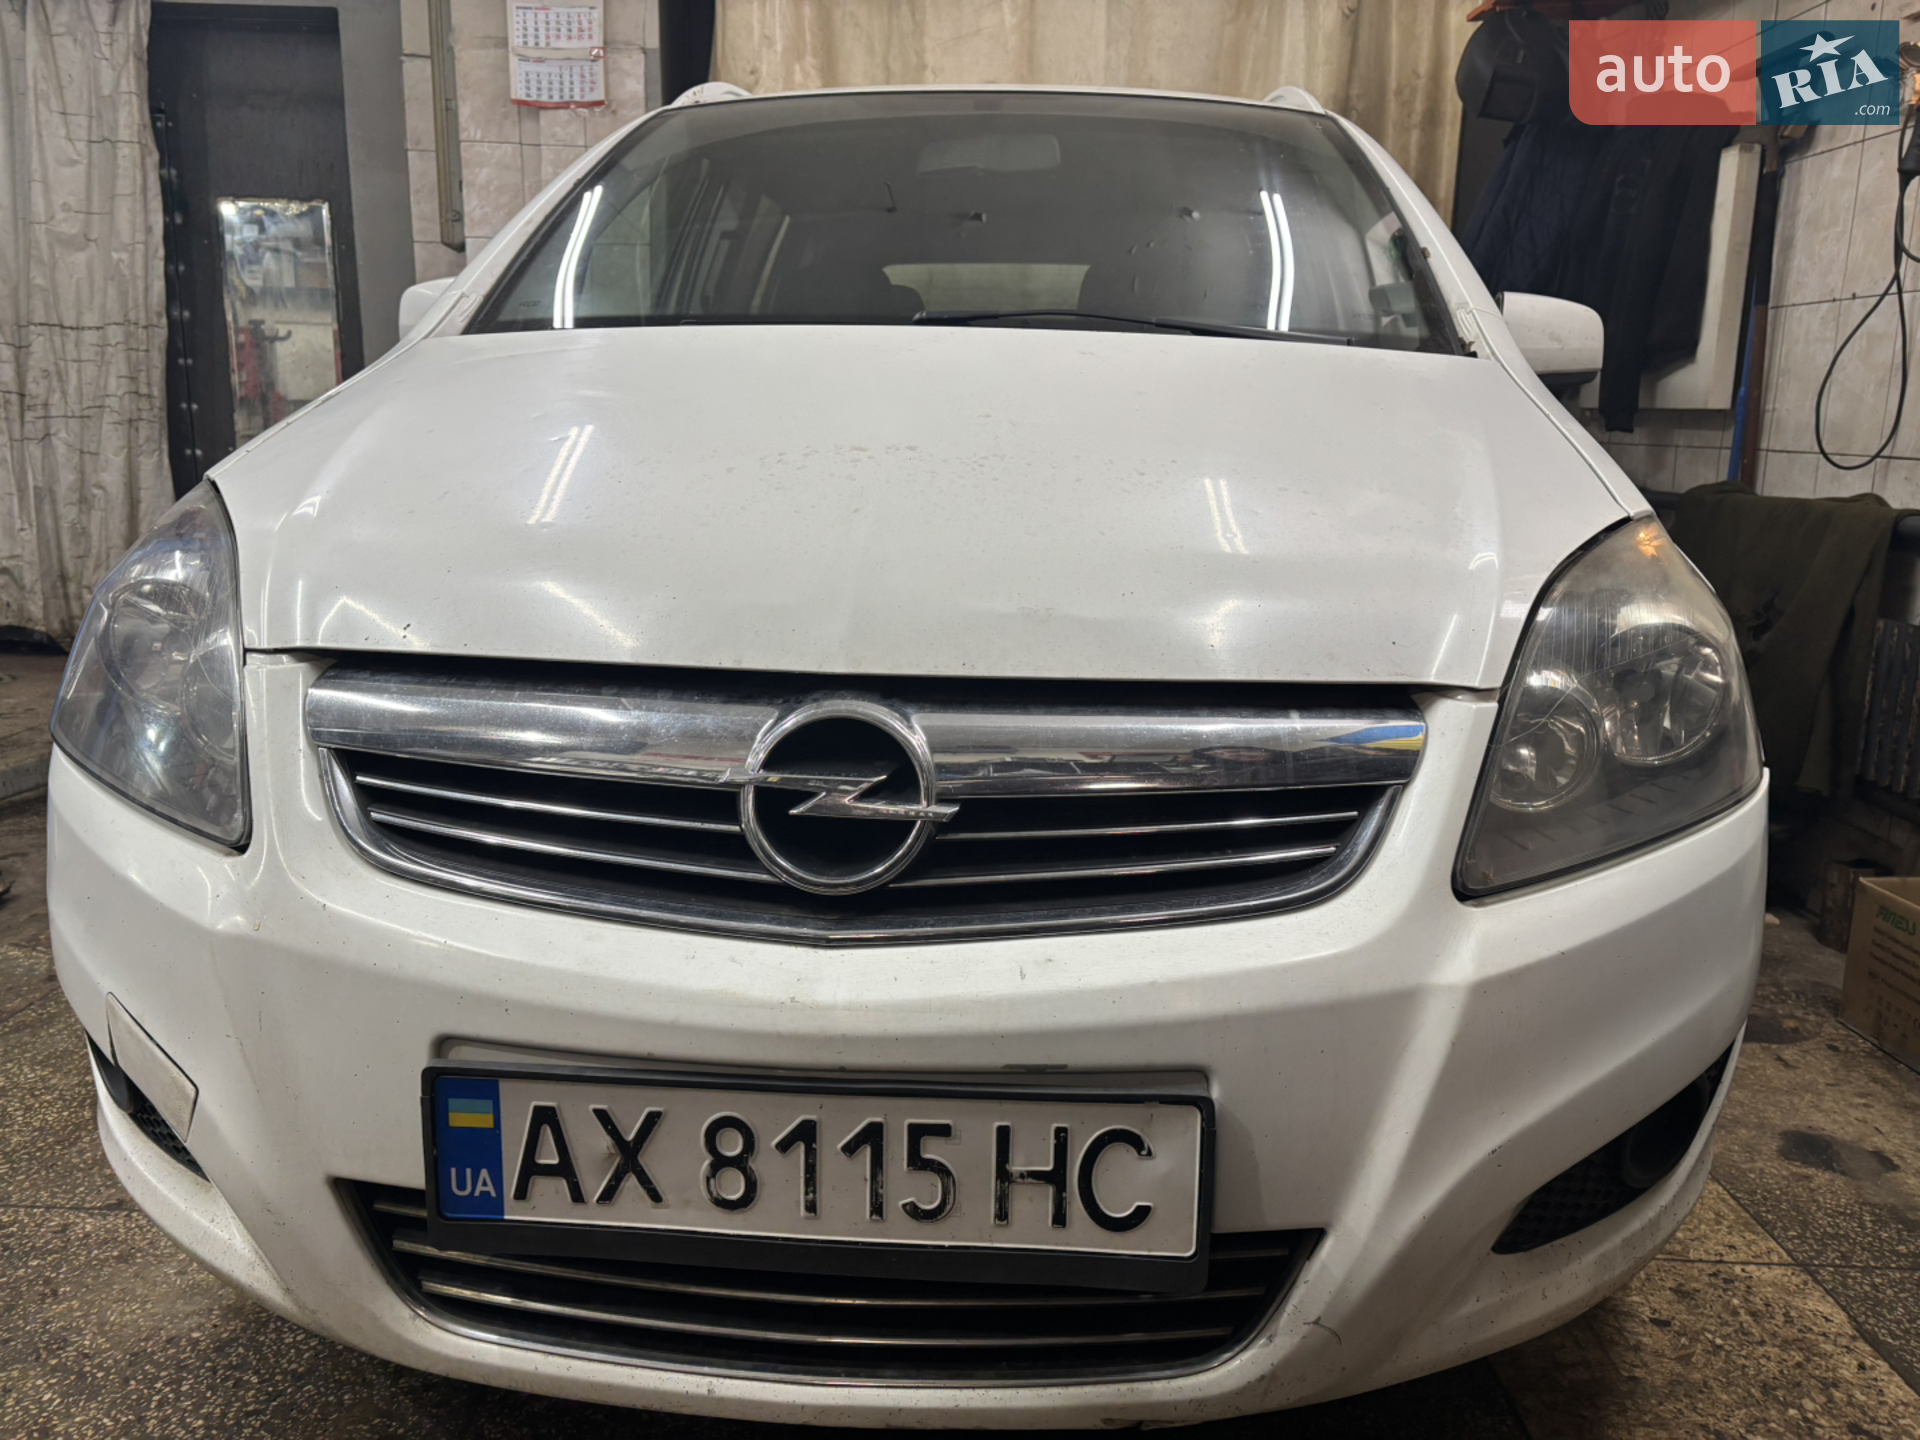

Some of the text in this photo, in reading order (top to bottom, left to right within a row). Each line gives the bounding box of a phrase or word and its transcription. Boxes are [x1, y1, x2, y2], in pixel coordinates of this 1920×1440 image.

[450, 1100, 1154, 1233] UA AX 8115 HC
